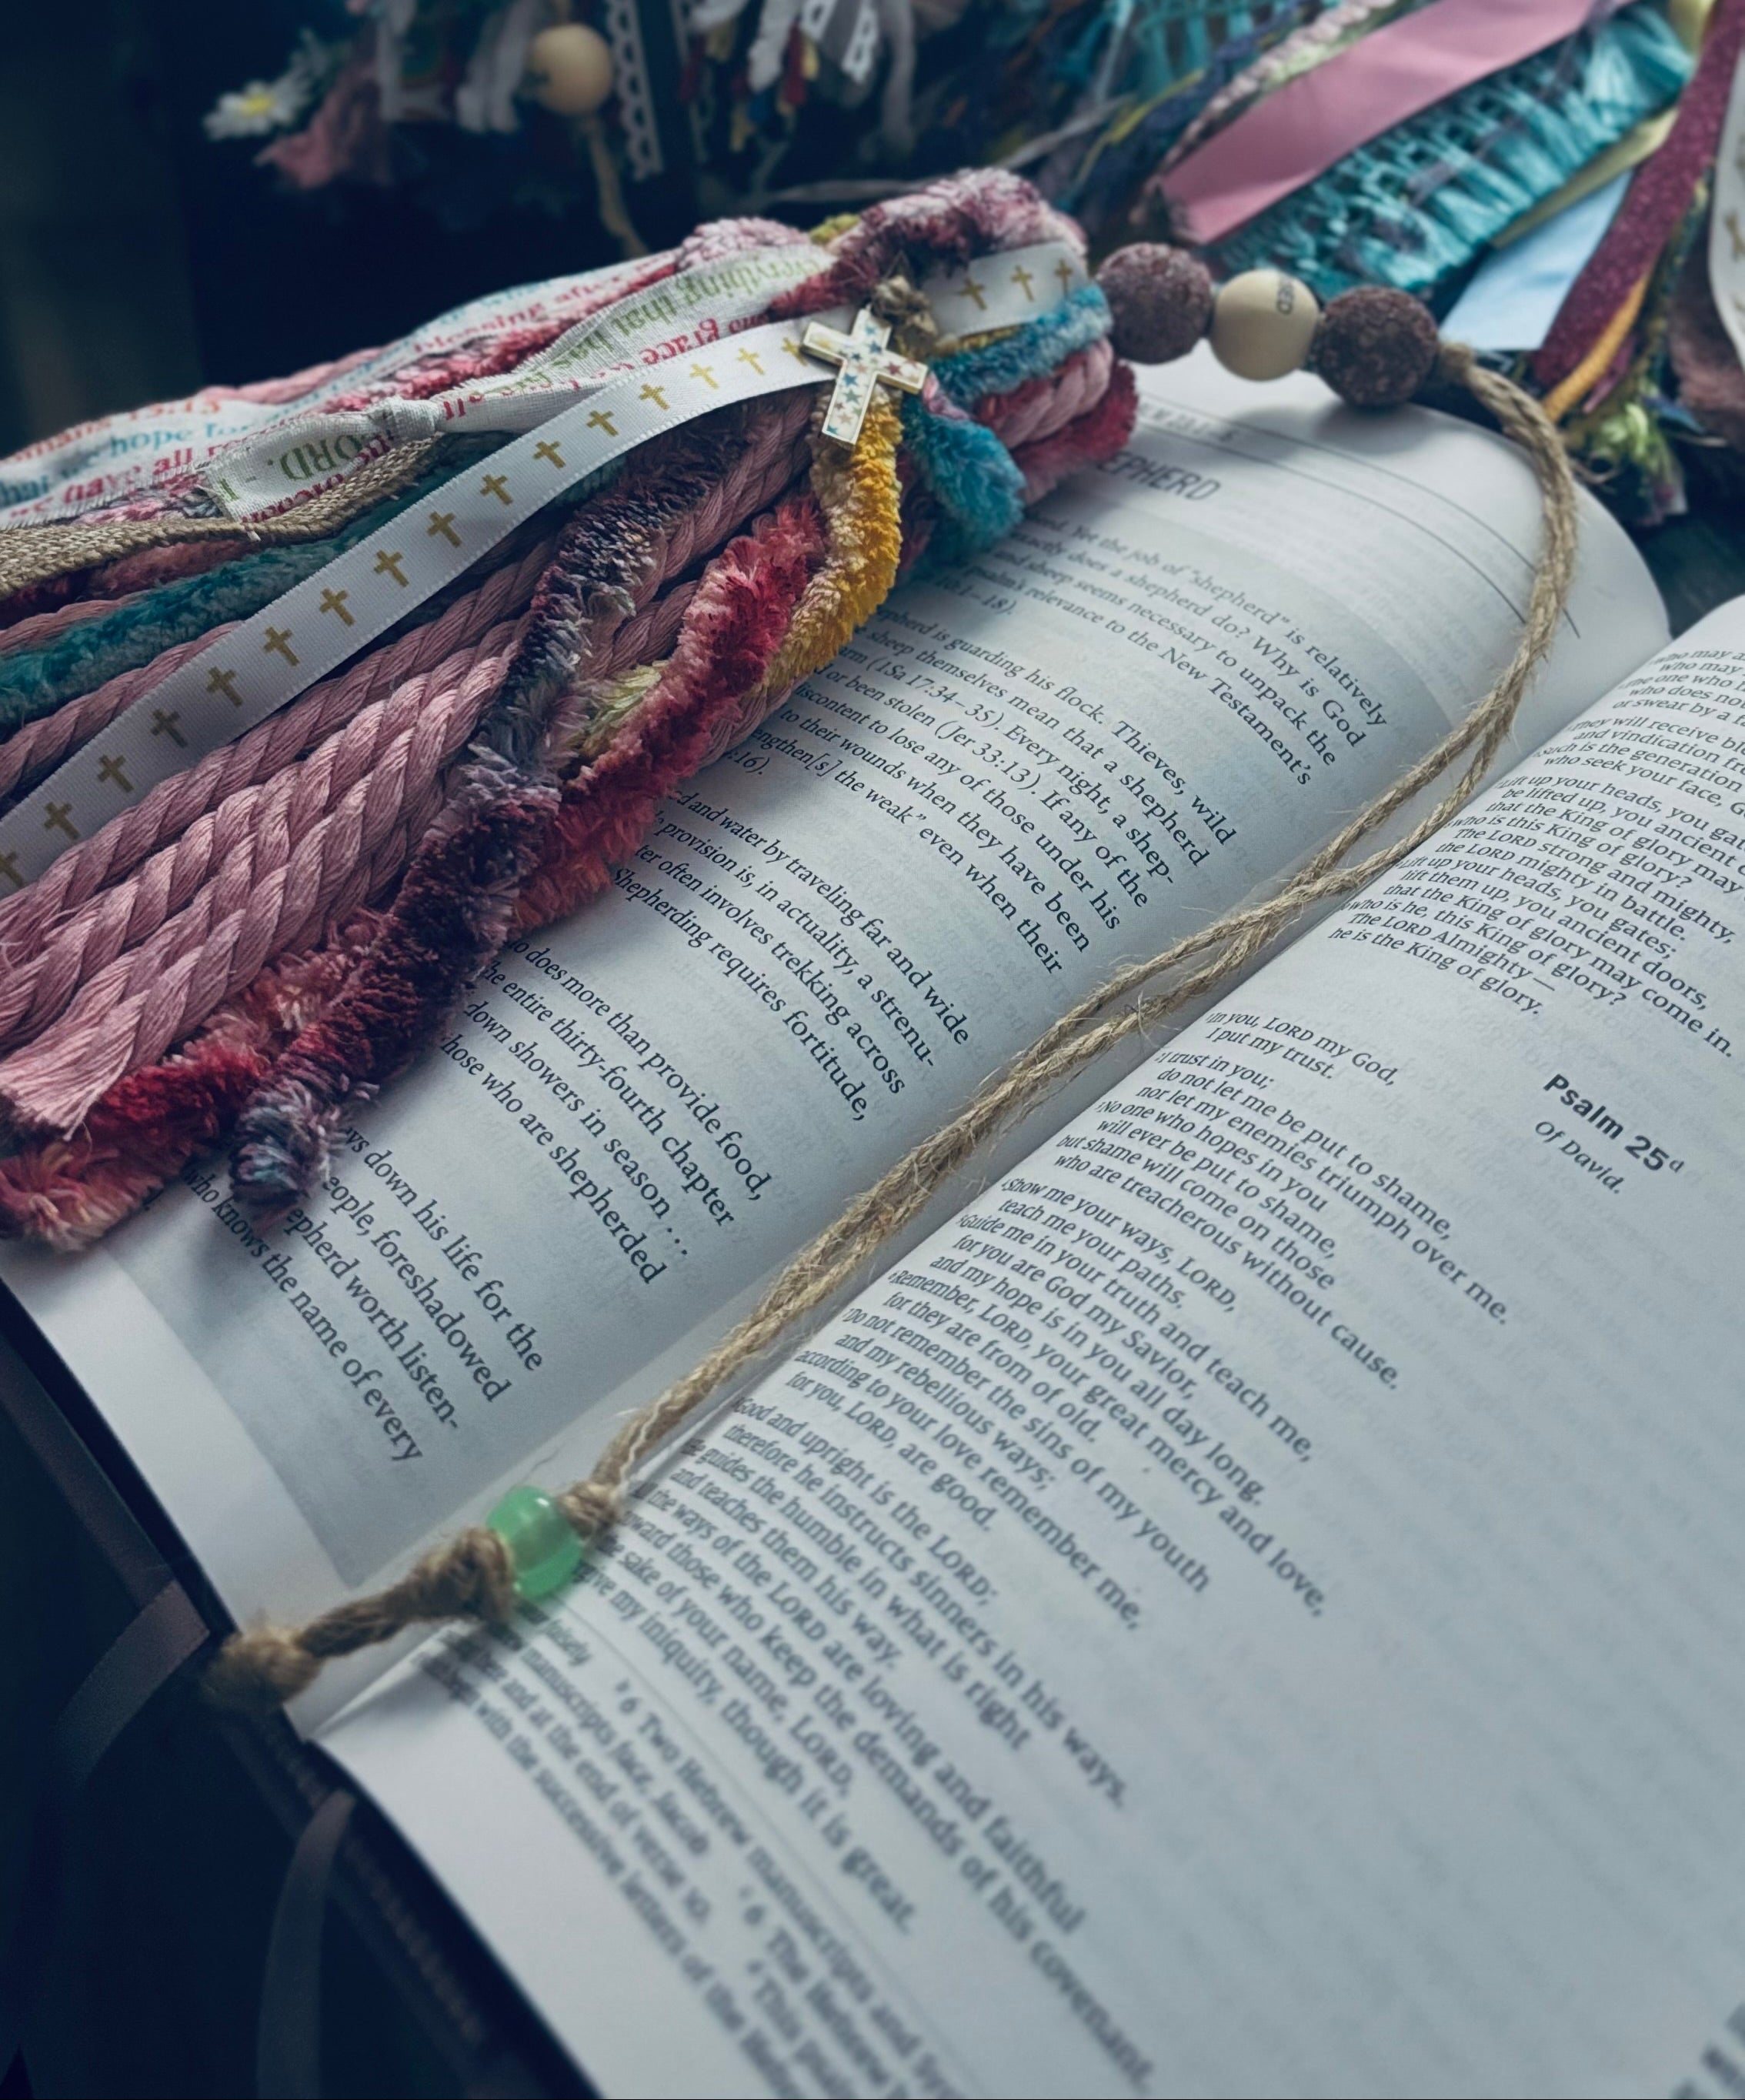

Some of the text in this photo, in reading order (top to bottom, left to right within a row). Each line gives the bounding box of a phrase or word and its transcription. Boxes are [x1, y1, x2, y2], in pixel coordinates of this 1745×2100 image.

[612, 296, 676, 339] that
[639, 318, 720, 365] grace
[109, 429, 185, 458] hope
[153, 447, 193, 476] all
[267, 434, 369, 481] ORD.
[1099, 451, 1222, 502] EPHERD
[1025, 583, 1103, 624] relevance
[1105, 616, 1126, 634] to
[1127, 628, 1160, 653] the
[1158, 646, 1208, 679] New
[1207, 677, 1312, 785] Testament’s
[1100, 533, 1129, 556] the
[1127, 543, 1160, 566] job
[1162, 555, 1192, 576] of
[1285, 629, 1305, 645] is
[1304, 646, 1387, 726] relatively
[1660, 661, 1741, 676] who may
[931, 631, 1237, 846] is guarding his flock. Thieves, wild
[1003, 724, 1061, 766] Every
[1056, 763, 1111, 815] night,
[1112, 813, 1127, 830] a
[1125, 828, 1174, 884] shep-
[1543, 755, 1723, 809] who seek your face,
[754, 726, 1063, 975] engthen[s] the weak” even when their
[1453, 827, 1736, 944] The LORD strong and mighty,
[687, 801, 969, 1046] and water by traveling far and wide
[1327, 927, 1543, 1015] he is the King of glory.
[1425, 873, 1478, 891] them
[1480, 884, 1510, 903] up,
[1512, 896, 1557, 920] you
[1556, 915, 1642, 964] ancient
[1641, 961, 1707, 1010] doors,
[613, 866, 867, 1121] Shepherding requires fortitude,
[1205, 1027, 1334, 1080] I put my trust.
[1222, 1013, 1261, 1028] you,
[1262, 1017, 1314, 1041] LORD
[1313, 1037, 1353, 1058] my
[1351, 1052, 1399, 1087] God,
[502, 982, 735, 1227] entire thirty-fourth chapter
[525, 947, 772, 1201] does more than provide food,
[1543, 1073, 1627, 1140] Psalm
[440, 1035, 668, 1285] hose who are shepherded
[1156, 1067, 1450, 1240] do not let me be put to shame,
[1535, 1121, 1627, 1194] Of David.
[261, 1252, 299, 1294] the
[289, 1290, 349, 1359] name
[323, 1177, 512, 1403] eople, foreshadowed
[363, 1149, 542, 1371] down his life for the
[952, 1234, 1197, 1400] for you are God my Savior,
[1053, 1154, 1398, 1390] who are treacherous without cause.
[342, 1358, 383, 1389] of
[362, 1388, 423, 1462] every
[834, 1334, 1055, 1491] and my rebellious ways;
[785, 1371, 997, 1531] for you, LORD, are good.
[909, 1571, 1129, 1808] sinners in his ways.
[610, 1590, 645, 1619] my
[640, 1616, 721, 1706] iniquity,
[719, 1697, 806, 1799] though
[840, 1843, 916, 1935] great.
[676, 1758, 750, 1847] Hebrew
